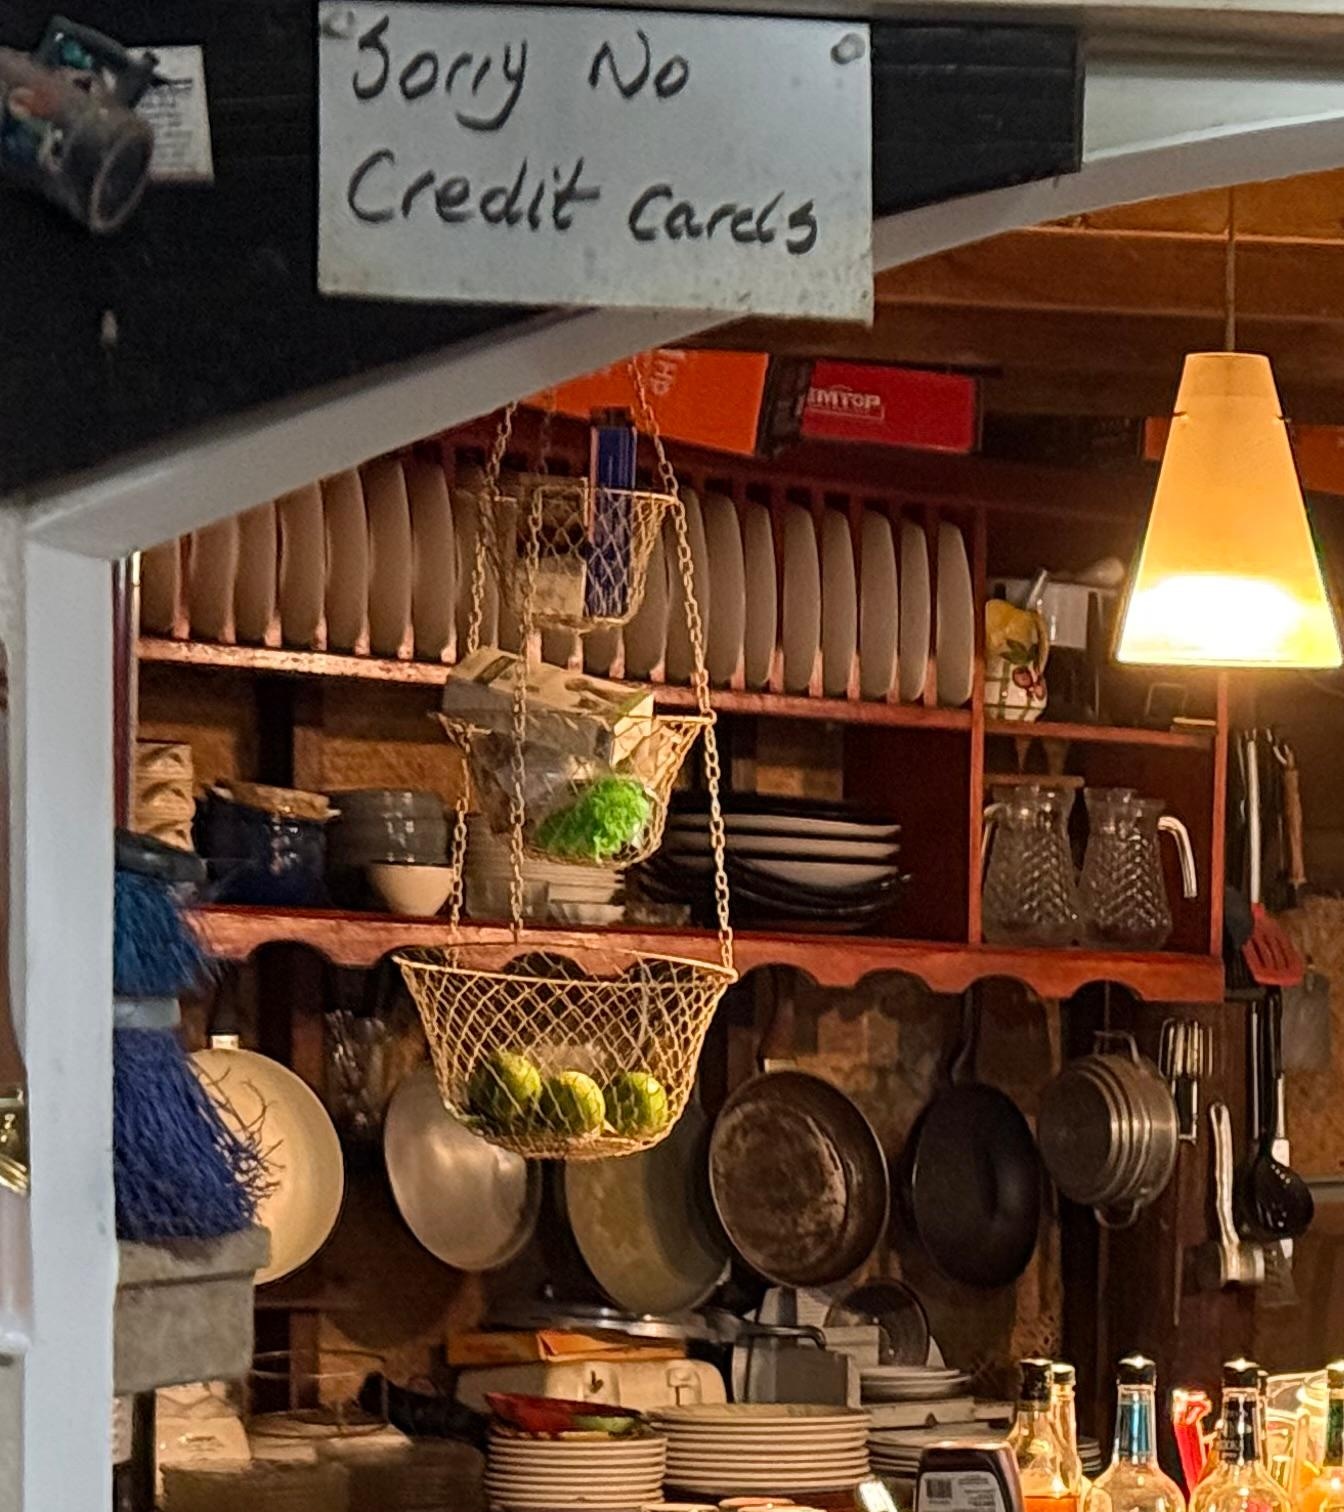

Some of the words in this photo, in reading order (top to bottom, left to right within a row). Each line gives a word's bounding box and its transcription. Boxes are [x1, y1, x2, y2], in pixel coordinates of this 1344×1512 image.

[350, 13, 527, 131] Sorry
[588, 28, 690, 100] No
[346, 150, 601, 232] Credit
[627, 190, 819, 255] Cards
